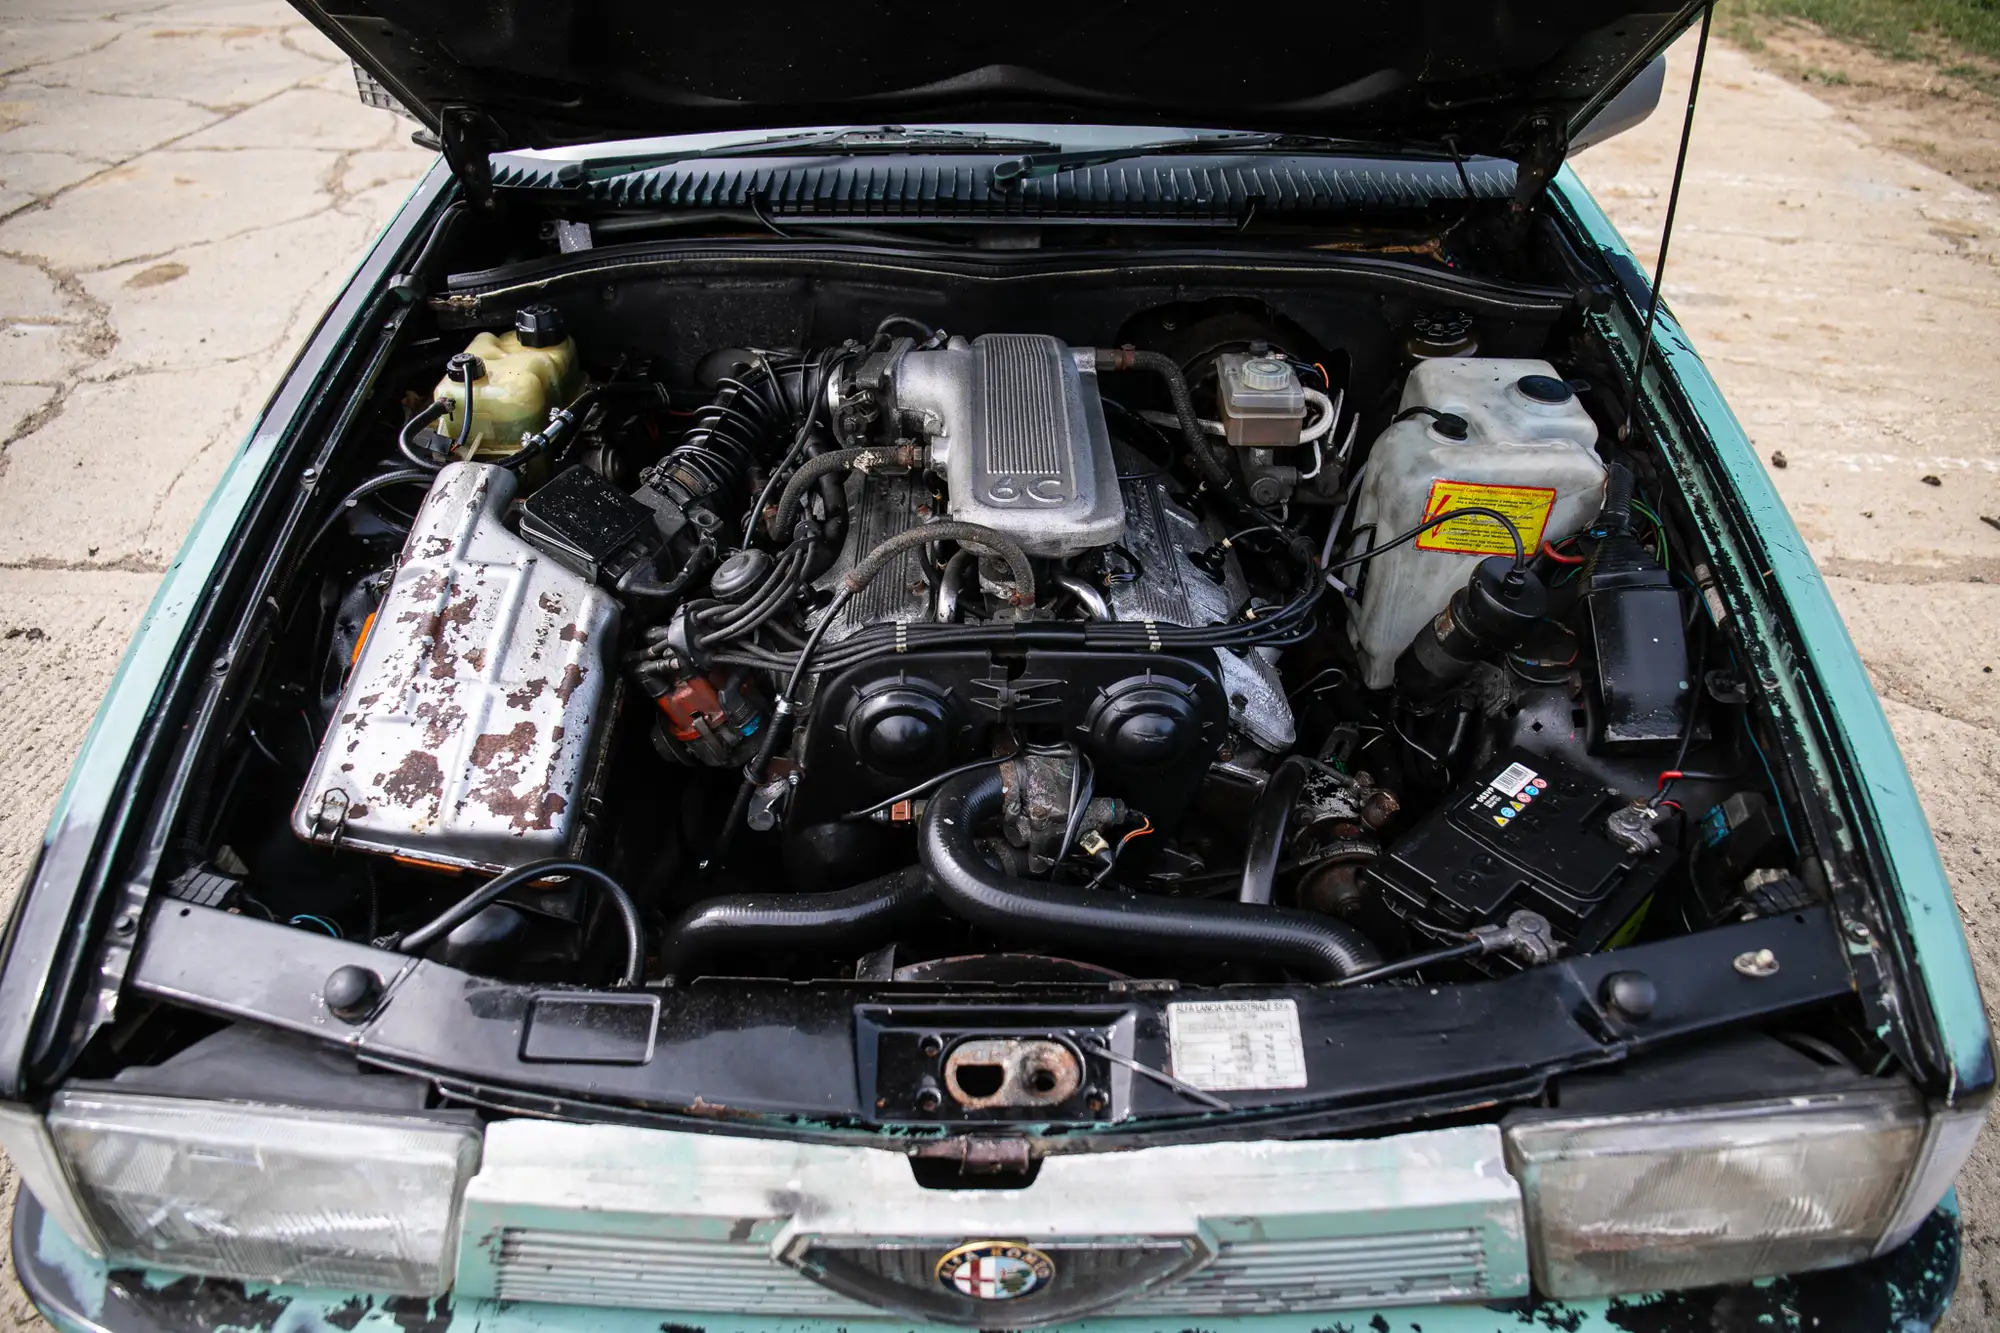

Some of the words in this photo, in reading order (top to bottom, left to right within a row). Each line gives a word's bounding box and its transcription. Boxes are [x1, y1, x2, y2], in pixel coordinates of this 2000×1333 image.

[988, 476, 1066, 503] 6C
[1175, 1004, 1194, 1013] ALFA
[1196, 1003, 1222, 1013] LANCIA
[1224, 1002, 1271, 1012] INDUSTRIALE
